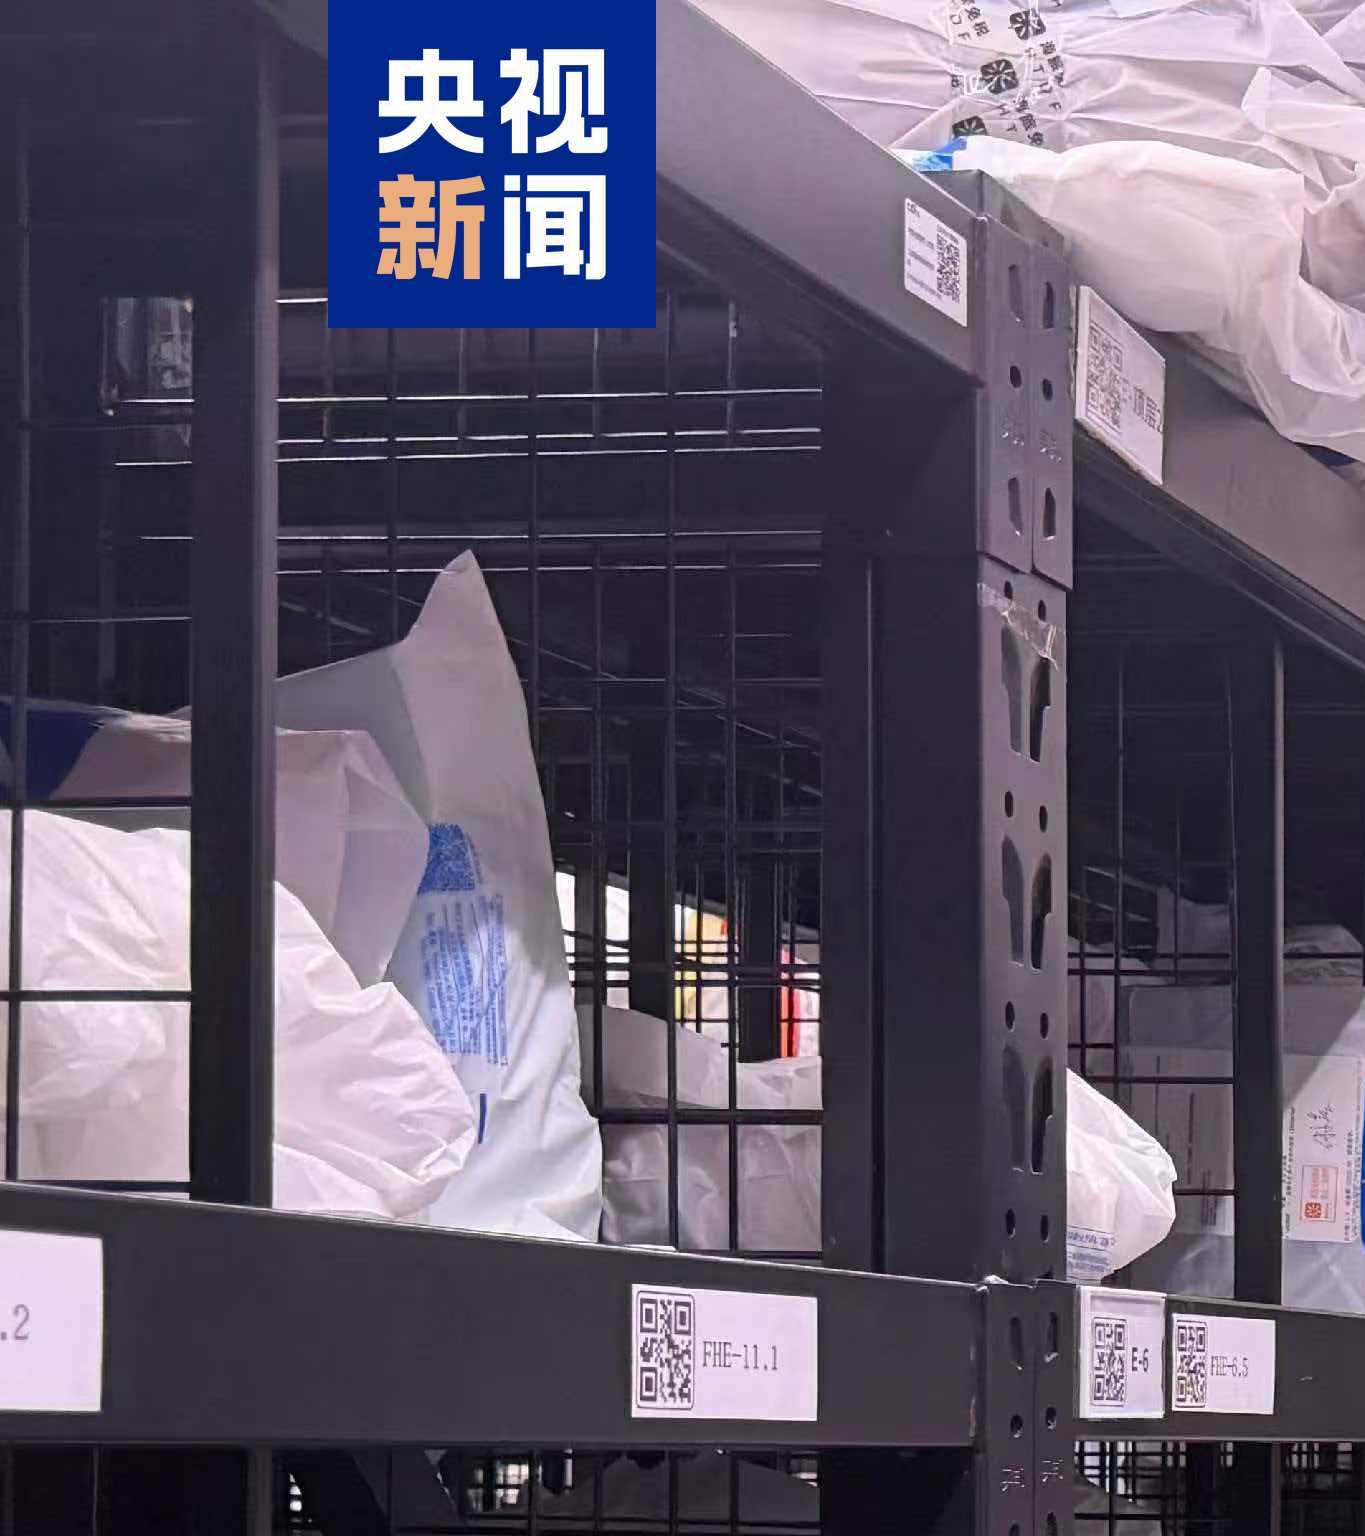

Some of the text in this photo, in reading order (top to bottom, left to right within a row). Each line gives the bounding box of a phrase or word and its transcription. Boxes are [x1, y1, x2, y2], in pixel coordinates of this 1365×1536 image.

[703, 1340, 778, 1371] FHE-11.1
[1131, 1347, 1150, 1373] E-6
[1210, 1355, 1249, 1377] FHE-6.5
